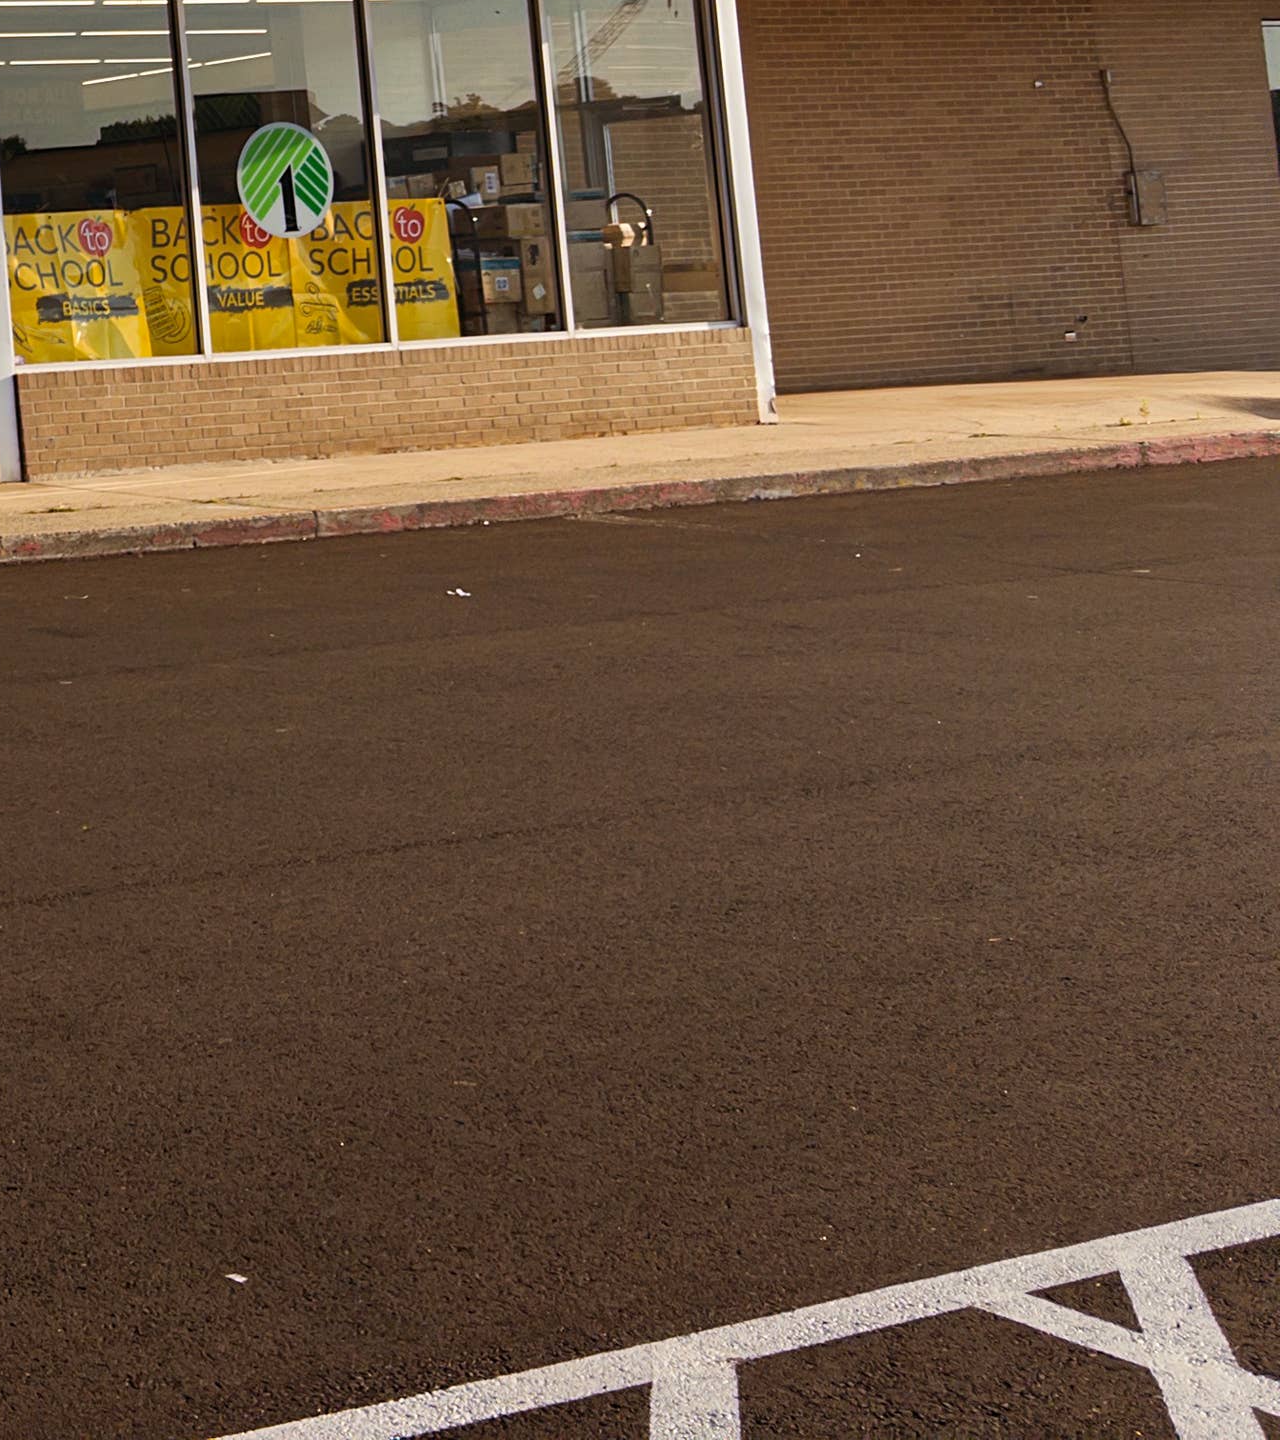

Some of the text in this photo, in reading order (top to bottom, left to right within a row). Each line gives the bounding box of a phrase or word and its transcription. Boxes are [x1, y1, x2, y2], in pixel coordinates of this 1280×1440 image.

[5, 221, 109, 256] ACK to
[310, 209, 422, 242] BAC to
[8, 259, 123, 290] CHOOL
[309, 245, 433, 276] SCHOL
[62, 300, 110, 316] BASICS
[216, 291, 265, 307] VALUE
[351, 285, 437, 302] ESSTIALS
